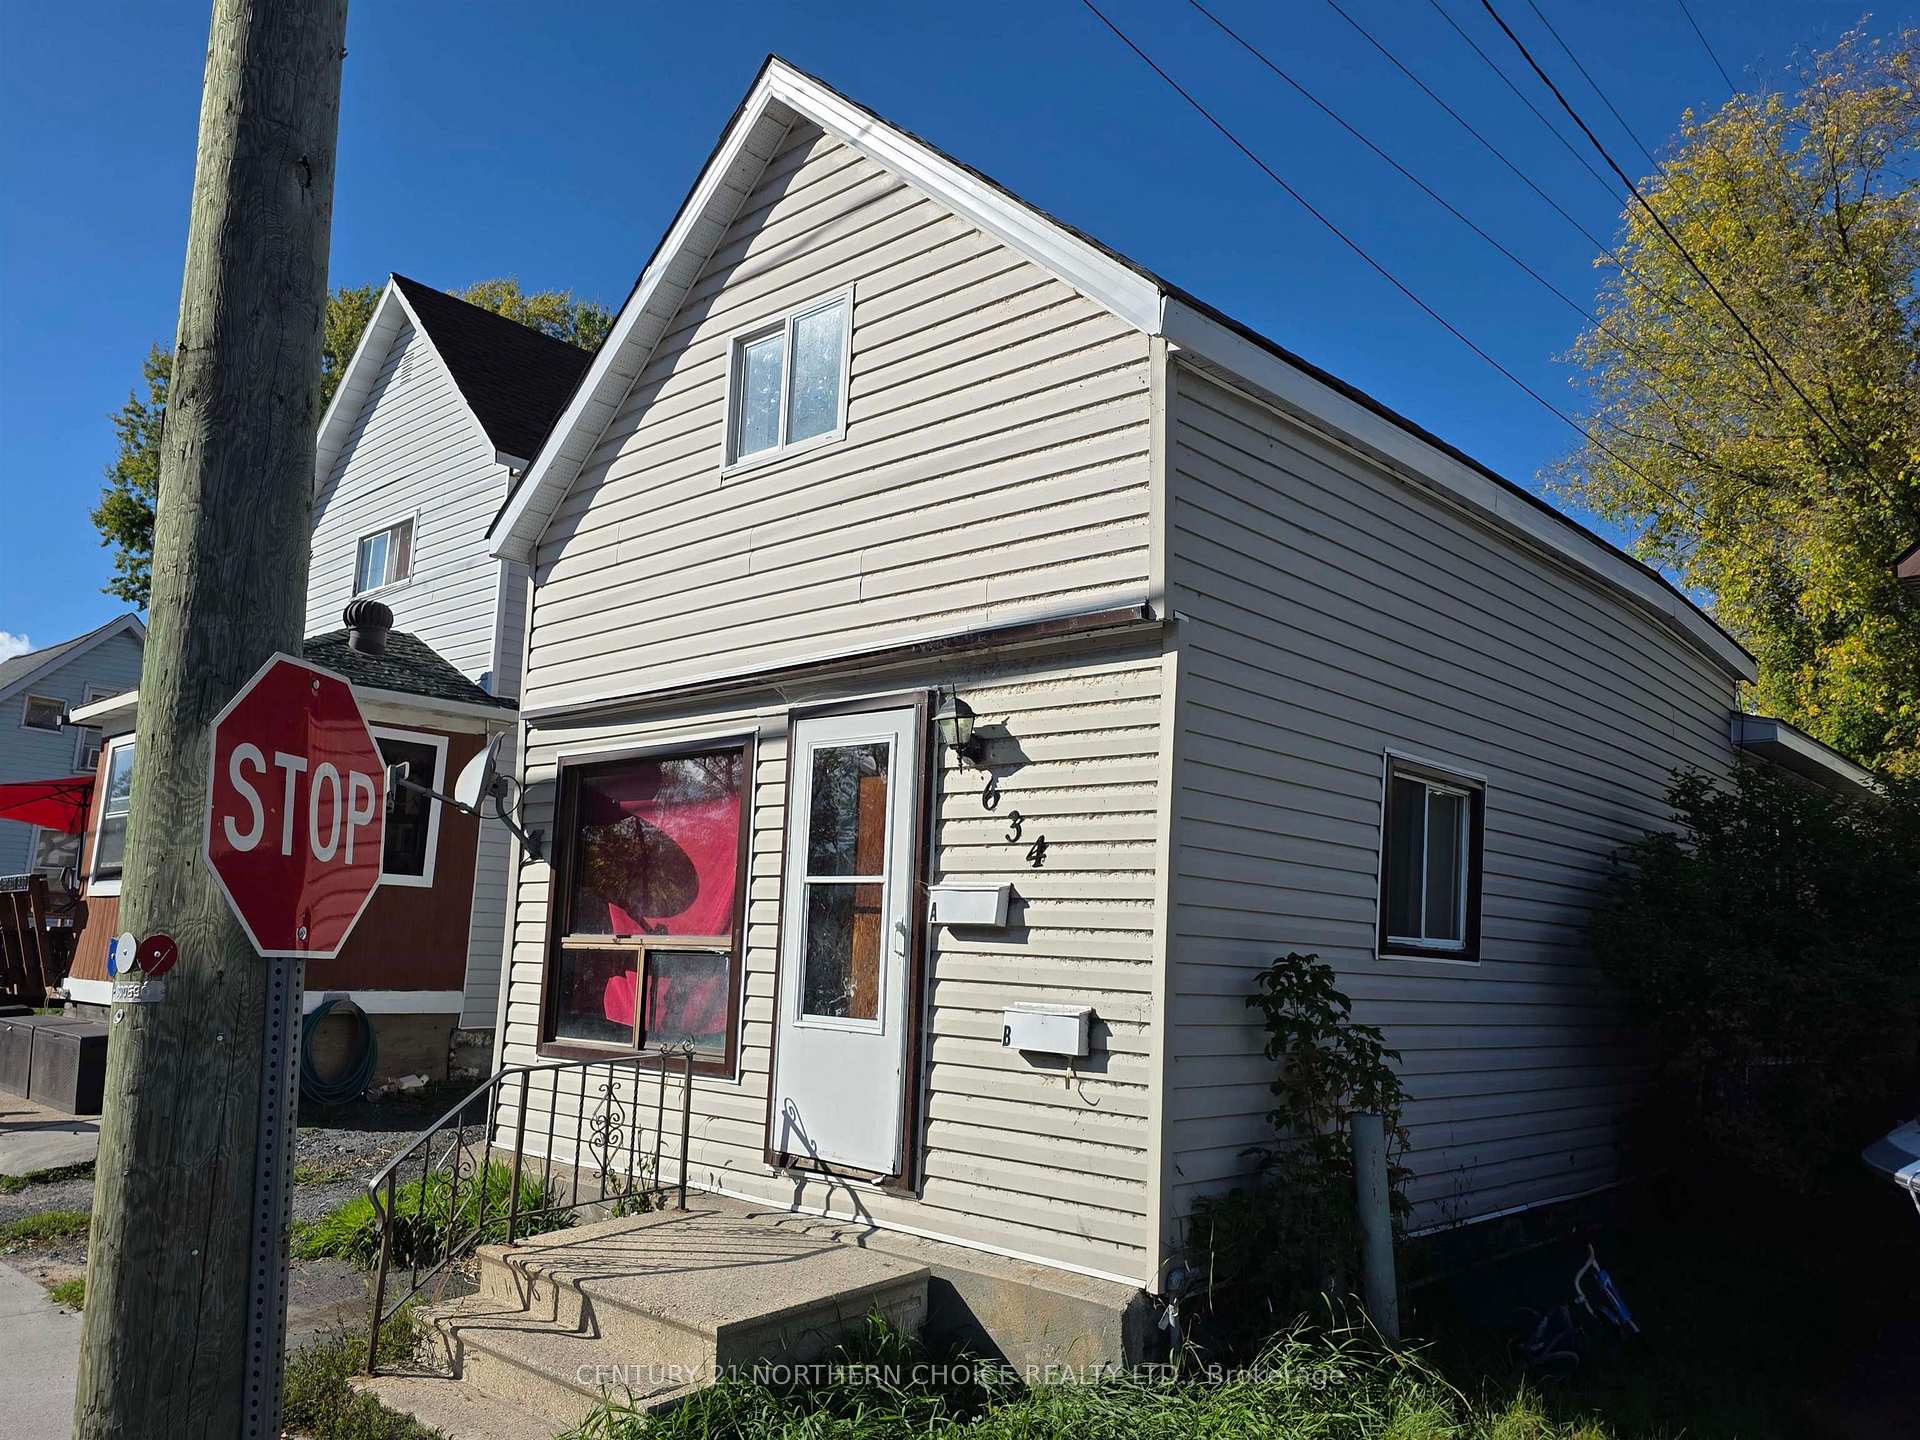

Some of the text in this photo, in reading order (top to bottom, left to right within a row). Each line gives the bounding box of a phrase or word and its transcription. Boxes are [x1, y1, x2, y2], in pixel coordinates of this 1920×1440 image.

[223, 742, 376, 865] STOP
[981, 773, 1050, 868] 634
[929, 901, 938, 922] A
[1002, 1024, 1012, 1047] B
